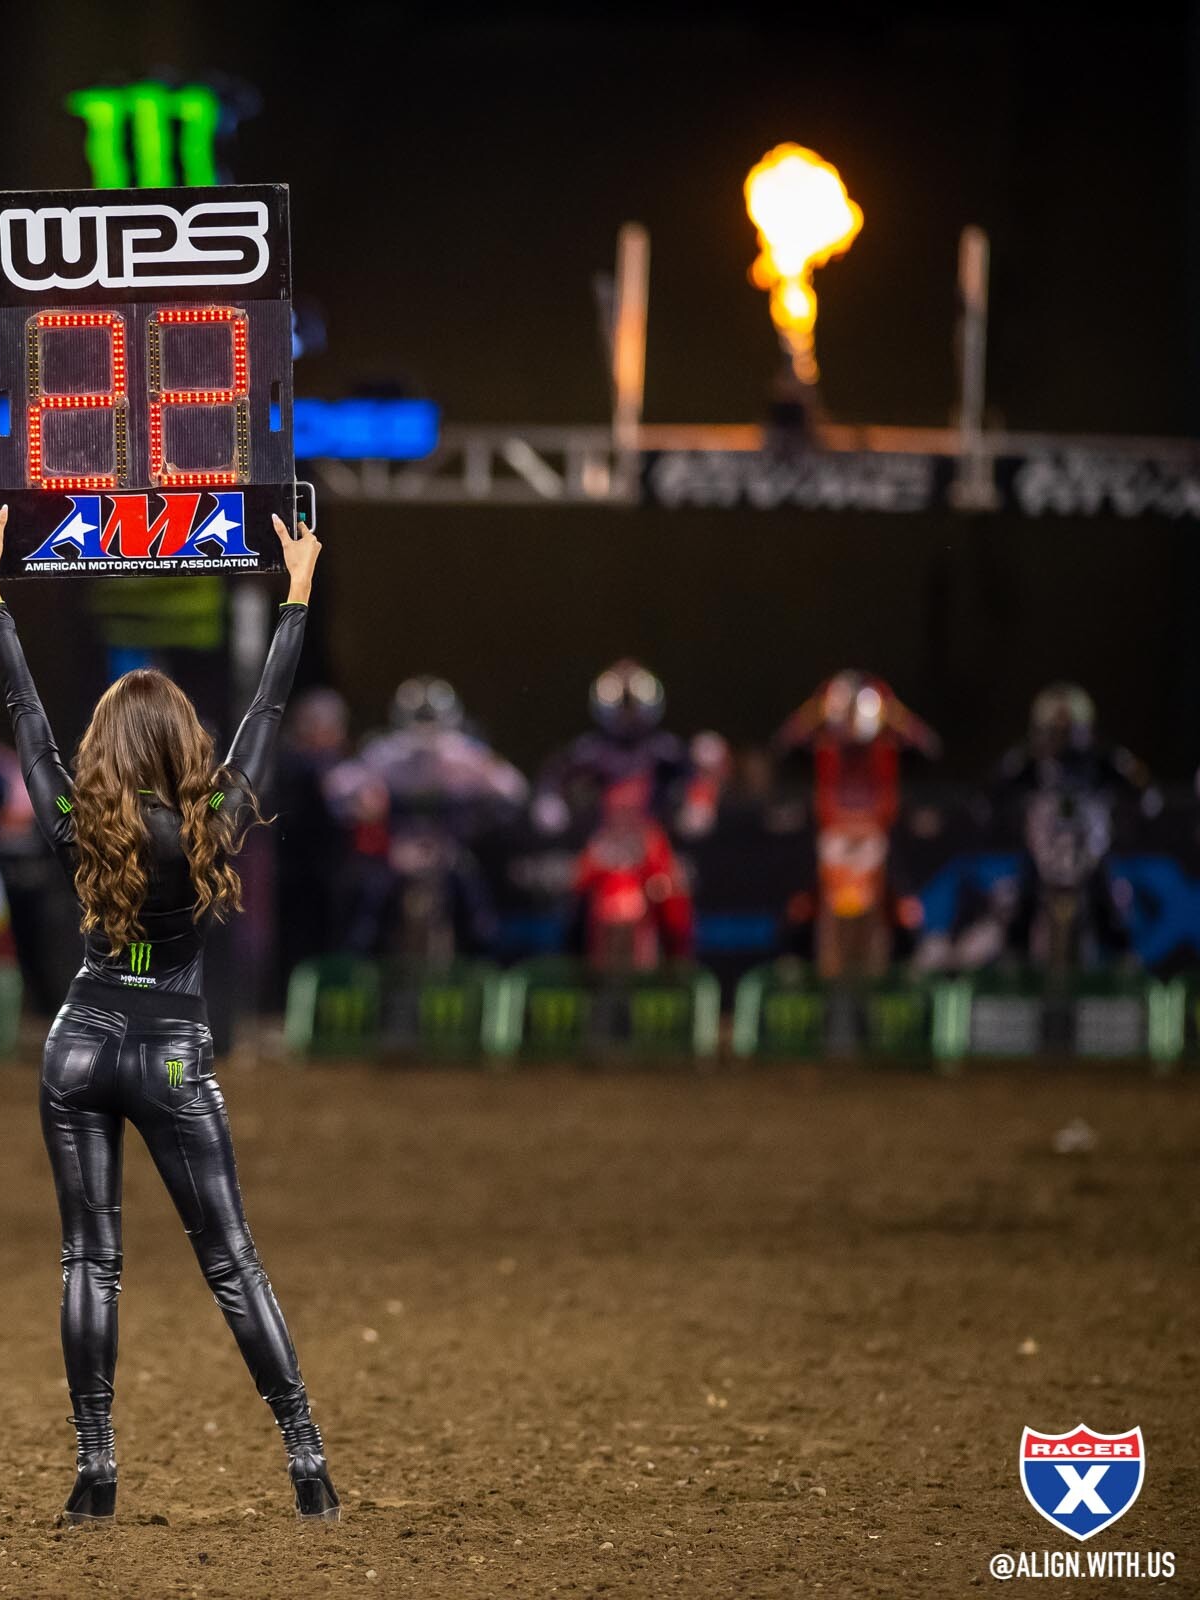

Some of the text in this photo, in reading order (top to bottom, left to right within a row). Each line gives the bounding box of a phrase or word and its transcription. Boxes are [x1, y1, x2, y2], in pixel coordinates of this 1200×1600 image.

[0, 201, 270, 291] WPS
[29, 309, 247, 490] 22
[22, 491, 260, 560] AMA
[25, 558, 258, 571] AMERICAN MOTORCYCLIST ASSOCIATION
[120, 974, 156, 984] MONSTER
